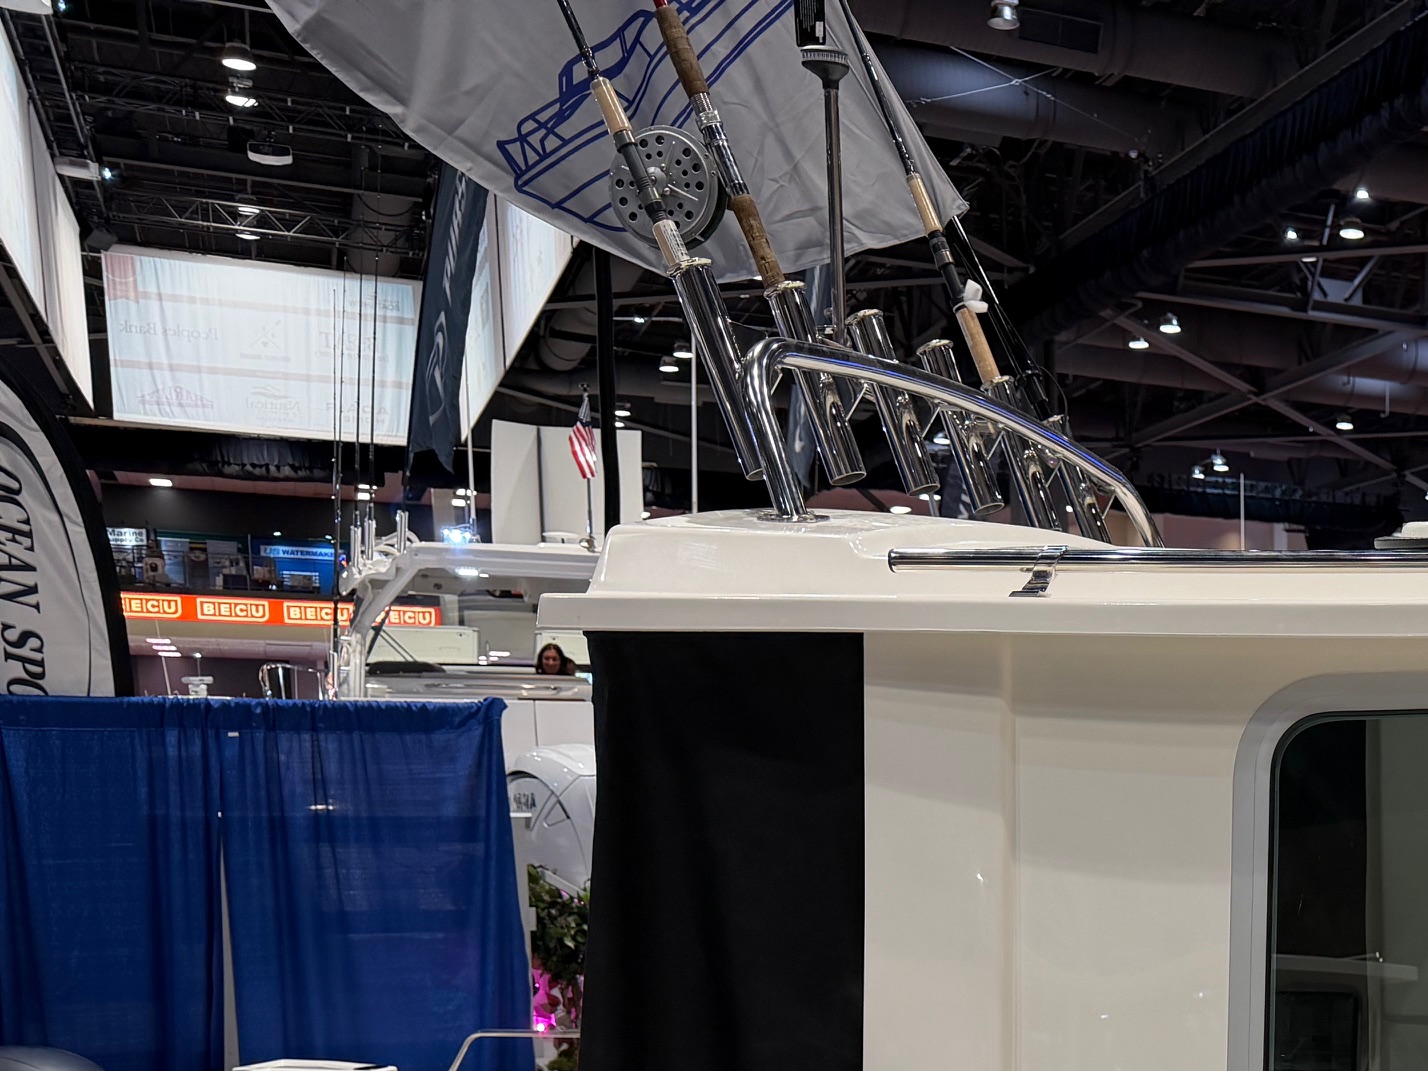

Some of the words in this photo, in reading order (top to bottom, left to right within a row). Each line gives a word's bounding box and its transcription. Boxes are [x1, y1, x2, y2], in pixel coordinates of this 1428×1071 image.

[107, 528, 144, 538] Marine
[123, 598, 177, 613] ECU
[202, 601, 264, 617] BECU
[389, 610, 434, 624] ECU
